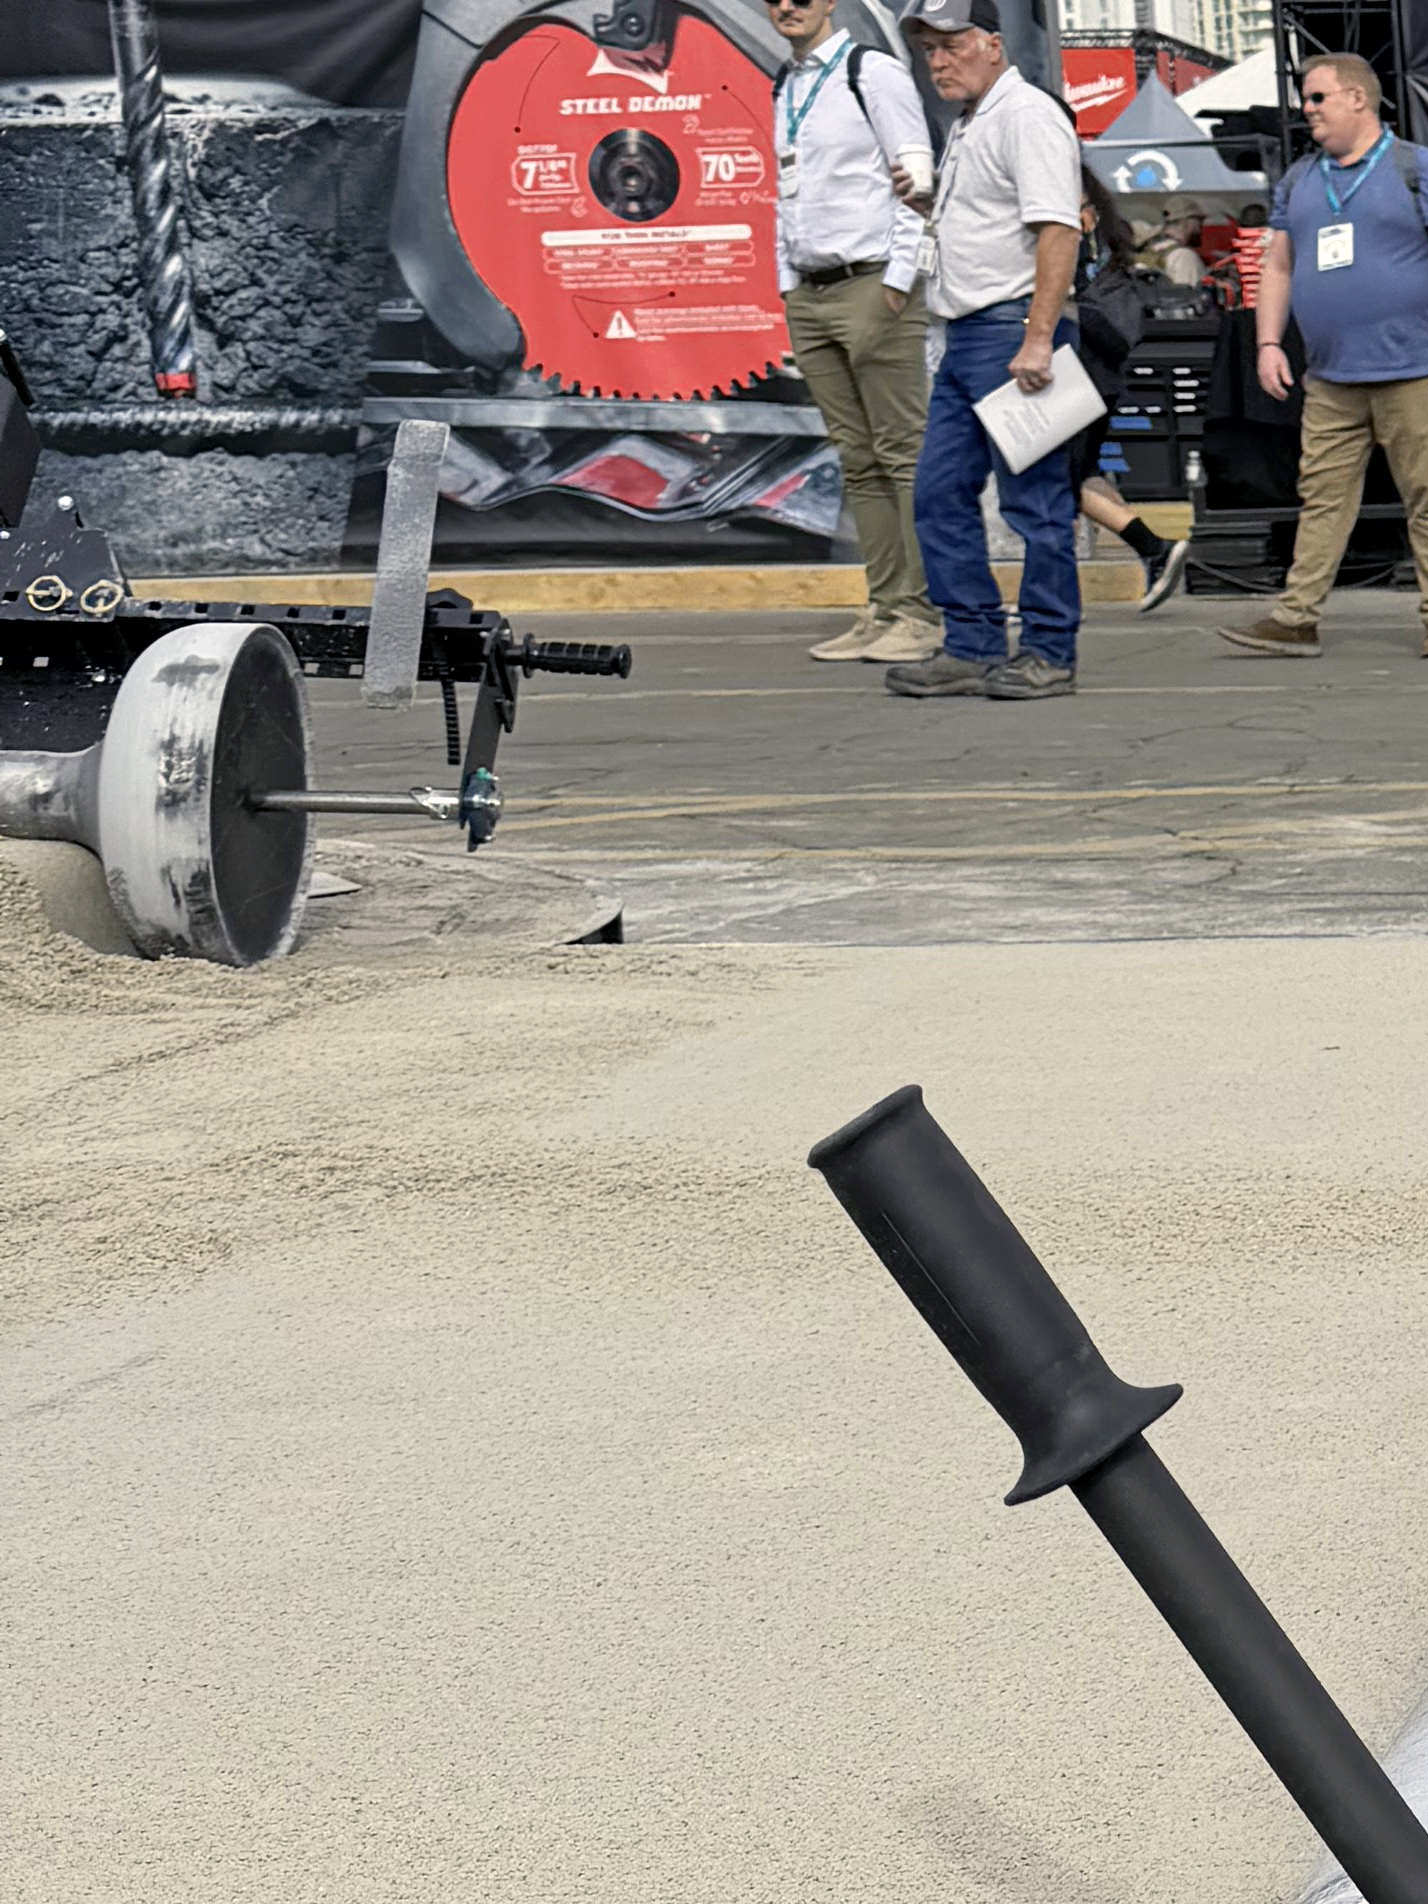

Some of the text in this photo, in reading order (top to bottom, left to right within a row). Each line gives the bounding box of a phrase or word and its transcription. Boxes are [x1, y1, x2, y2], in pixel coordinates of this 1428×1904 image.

[559, 94, 701, 115] STEEL DEMON
[704, 154, 735, 182] 70
